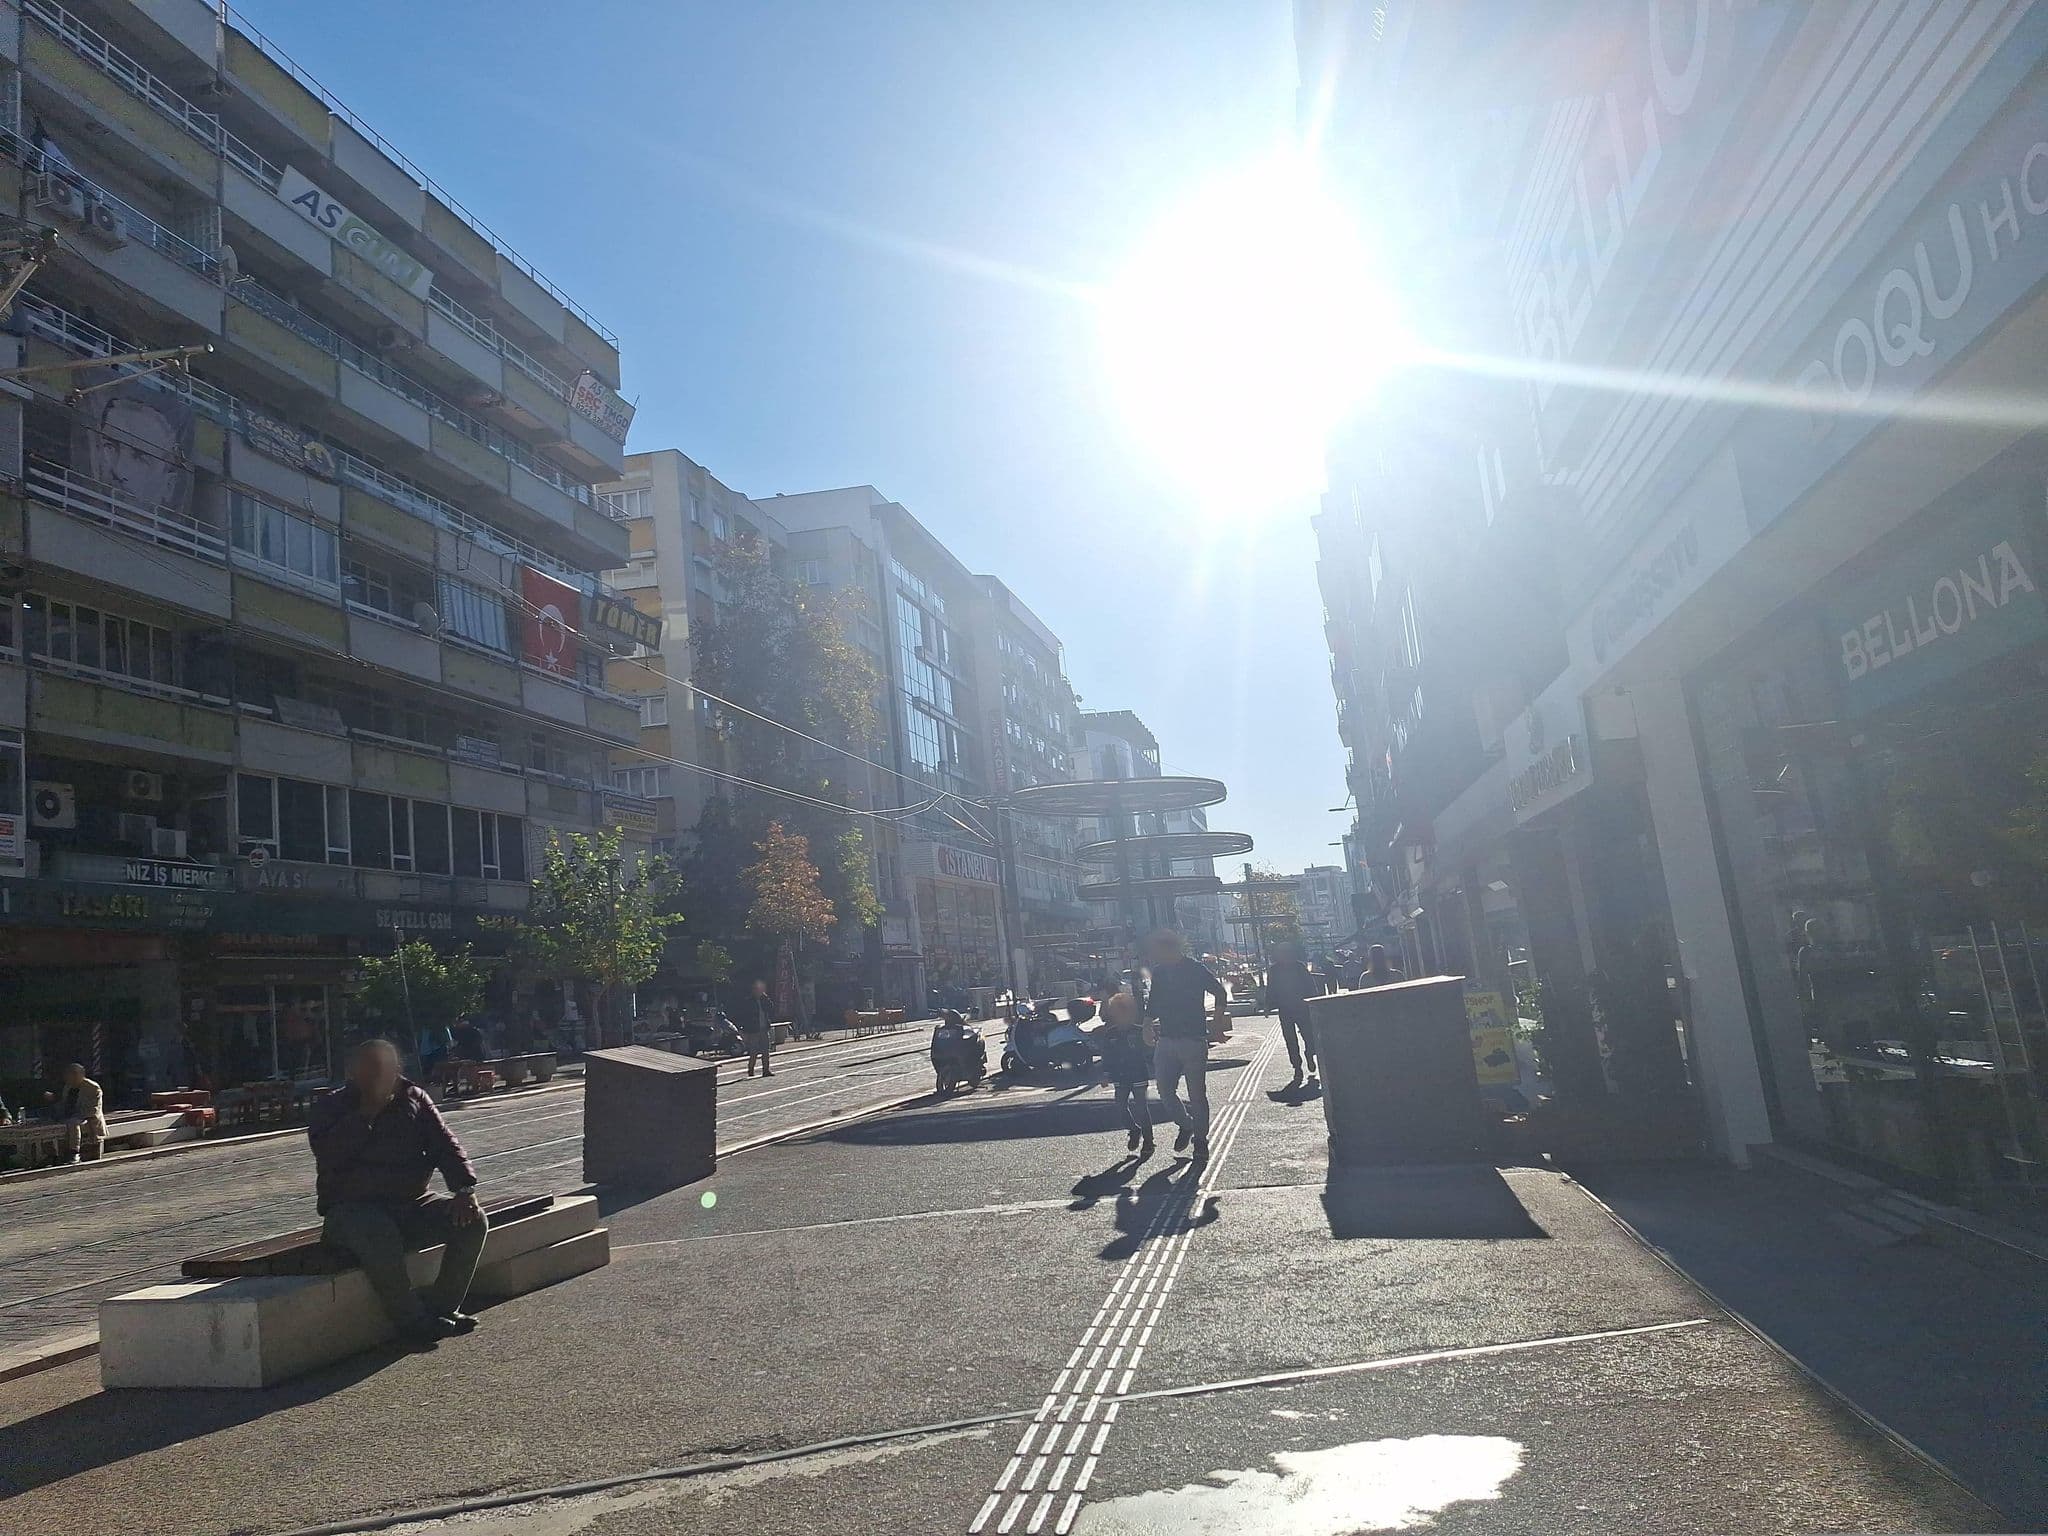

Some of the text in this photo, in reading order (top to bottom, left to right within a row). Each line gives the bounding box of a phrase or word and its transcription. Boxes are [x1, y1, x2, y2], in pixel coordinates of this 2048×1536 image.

[577, 386, 602, 410] SRC
[604, 403, 629, 428] TMGD
[1840, 540, 2034, 681] BELLONA
[172, 868, 228, 886] MERKE
